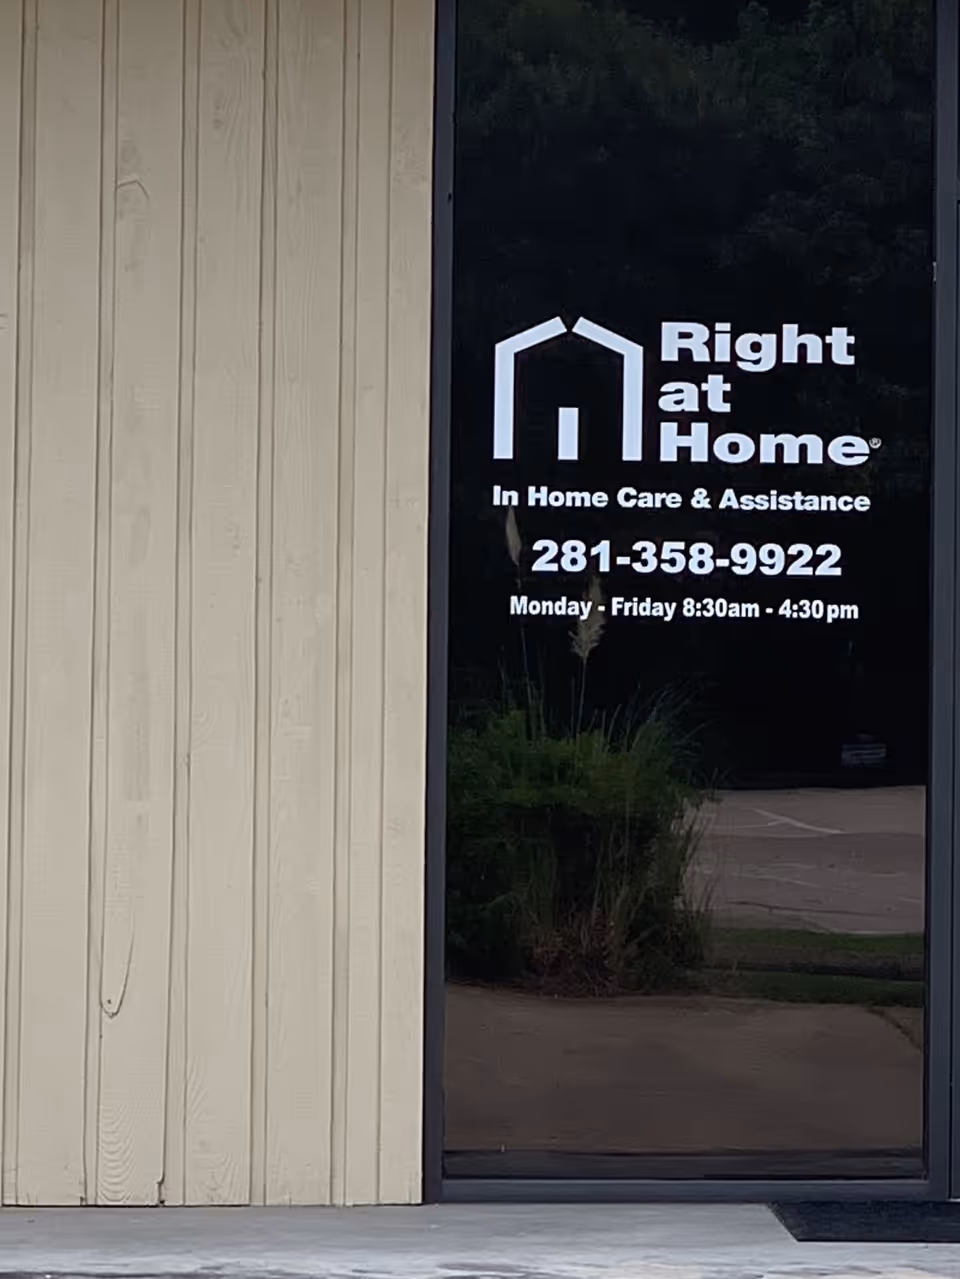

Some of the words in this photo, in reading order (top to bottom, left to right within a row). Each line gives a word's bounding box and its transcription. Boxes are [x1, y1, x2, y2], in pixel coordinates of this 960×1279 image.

[660, 321, 856, 373] Right
[658, 374, 732, 413] at
[492, 485, 519, 506] In
[527, 485, 609, 508] Home
[616, 486, 683, 509] Care
[690, 487, 712, 509] &
[718, 488, 871, 512] Assistance
[531, 539, 842, 576] 281-358-9922
[510, 595, 593, 621] Monday
[611, 596, 677, 622] Friday
[682, 597, 760, 618] 8:30am
[778, 598, 859, 624] 4:30pm
